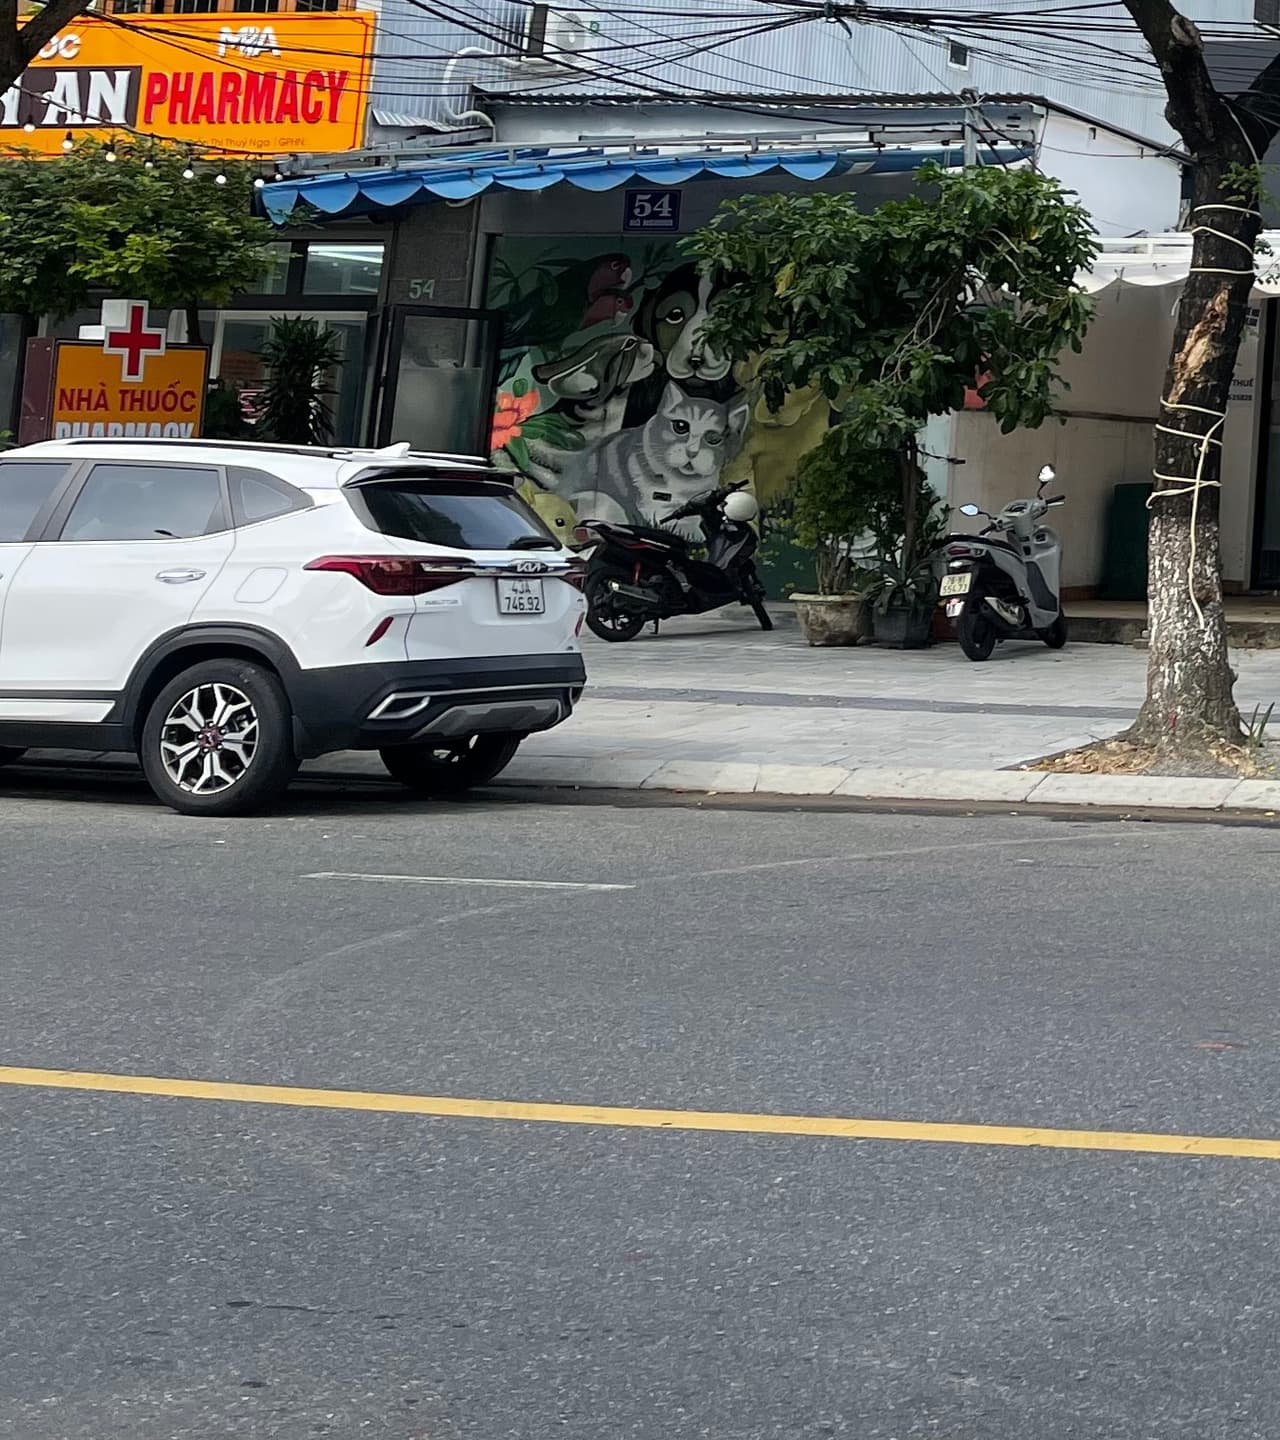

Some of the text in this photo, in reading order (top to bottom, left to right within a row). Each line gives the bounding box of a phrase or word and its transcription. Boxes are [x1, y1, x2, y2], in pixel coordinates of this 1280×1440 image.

[40, 70, 132, 126] AN
[144, 70, 349, 125] PHARMACY
[632, 193, 673, 218] 54
[409, 279, 436, 300] 54
[58, 380, 197, 413] NHÀ THUỐC
[504, 596, 541, 611] 746.92
